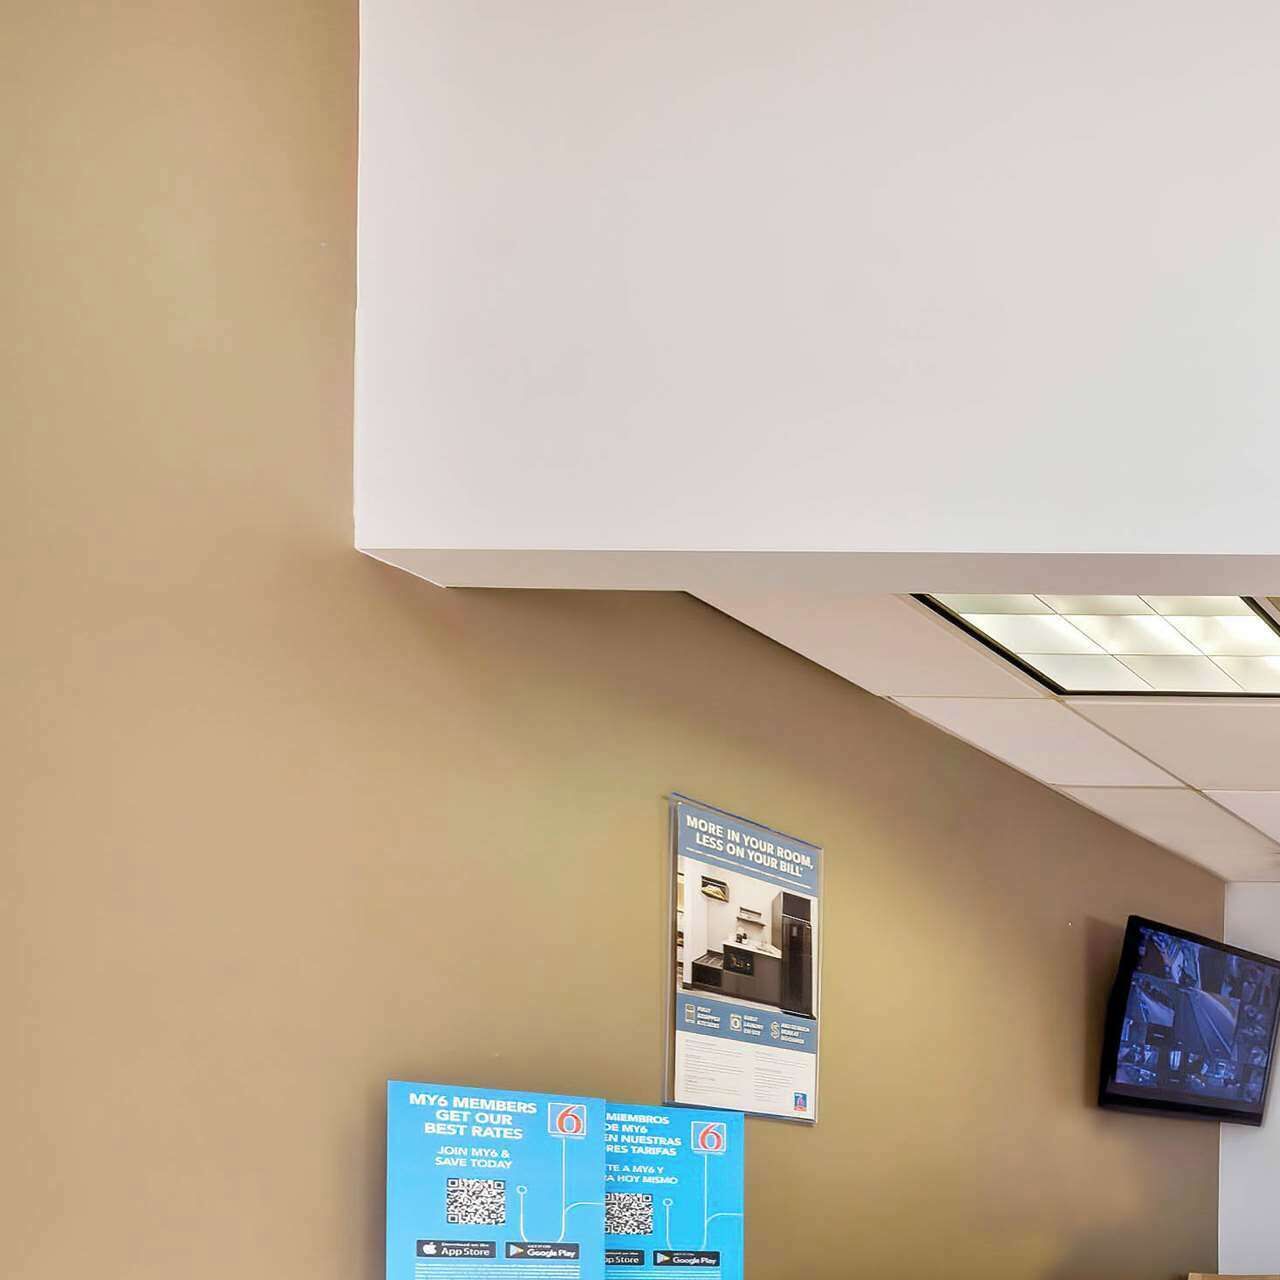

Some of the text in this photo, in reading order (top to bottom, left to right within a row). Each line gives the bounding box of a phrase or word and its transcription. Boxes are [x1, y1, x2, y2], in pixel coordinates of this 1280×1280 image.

[686, 814, 814, 870] MORE IN YOUR ROOM,
[696, 832, 724, 851] LESS
[726, 843, 745, 858] ON
[747, 849, 778, 869] YOUR
[409, 1092, 537, 1114] MY6 MEMBERS
[435, 1109, 513, 1125] GET OUR
[556, 1104, 584, 1135] 6
[606, 1112, 670, 1125] MIEMBROS
[424, 1122, 524, 1140] BEST RATES
[622, 1124, 648, 1133] MY6
[621, 1134, 682, 1146] NUESTRAS
[698, 1122, 723, 1151] 6
[437, 1146, 510, 1159] JOIN MY6 &
[631, 1145, 677, 1157] TARIFAS
[435, 1156, 513, 1169] SAVE TODAY
[632, 1165, 655, 1174] MY6
[617, 1175, 639, 1183] HOY
[642, 1175, 678, 1184] MISMO
[441, 1247, 490, 1258] App Store
[527, 1248, 576, 1259] Google Play
[615, 1256, 640, 1264] Store
[672, 1256, 716, 1265] Google Play
